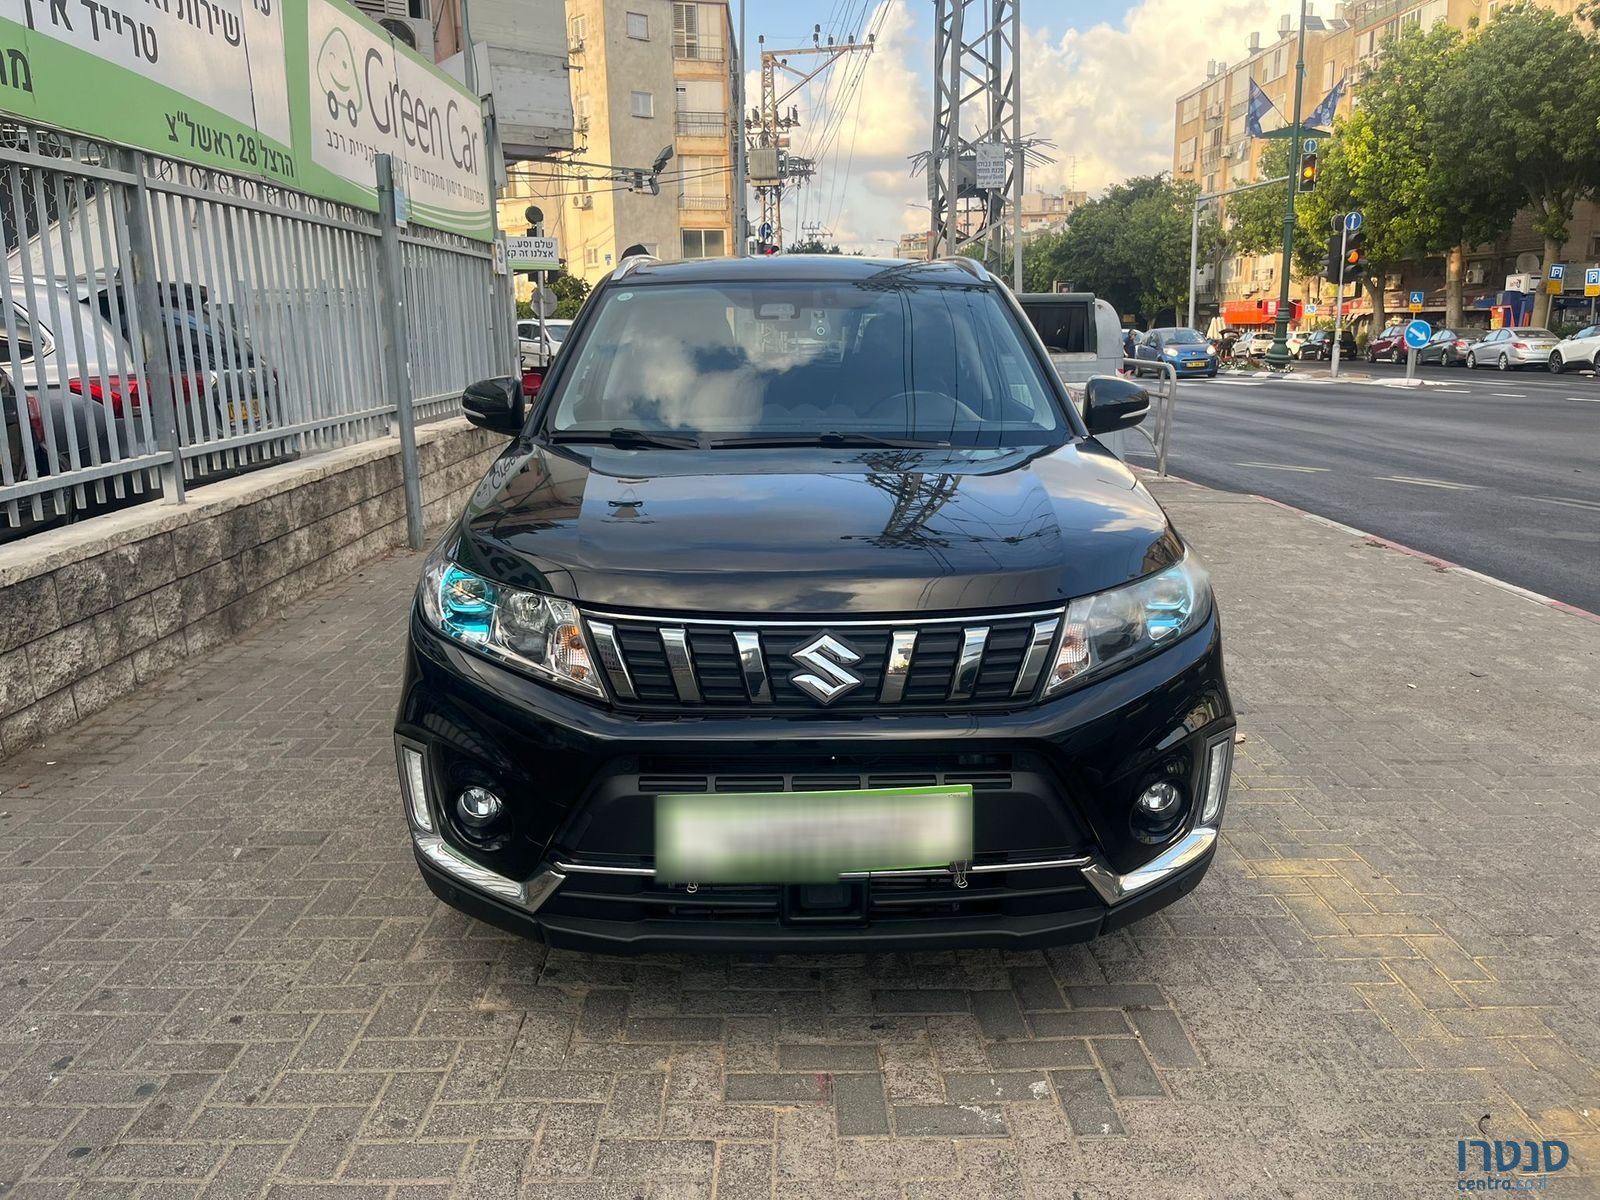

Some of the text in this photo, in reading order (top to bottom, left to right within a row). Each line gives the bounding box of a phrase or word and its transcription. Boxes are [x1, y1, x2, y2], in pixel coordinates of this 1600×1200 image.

[81, 0, 158, 64] טרייד
[365, 47, 477, 176] Green Car
[165, 110, 294, 178] הרצל 28 ראשל"צ
[326, 129, 346, 152] רכב
[519, 250, 529, 258] זה
[531, 249, 554, 258] אצלנו
[534, 240, 554, 249] שלם
